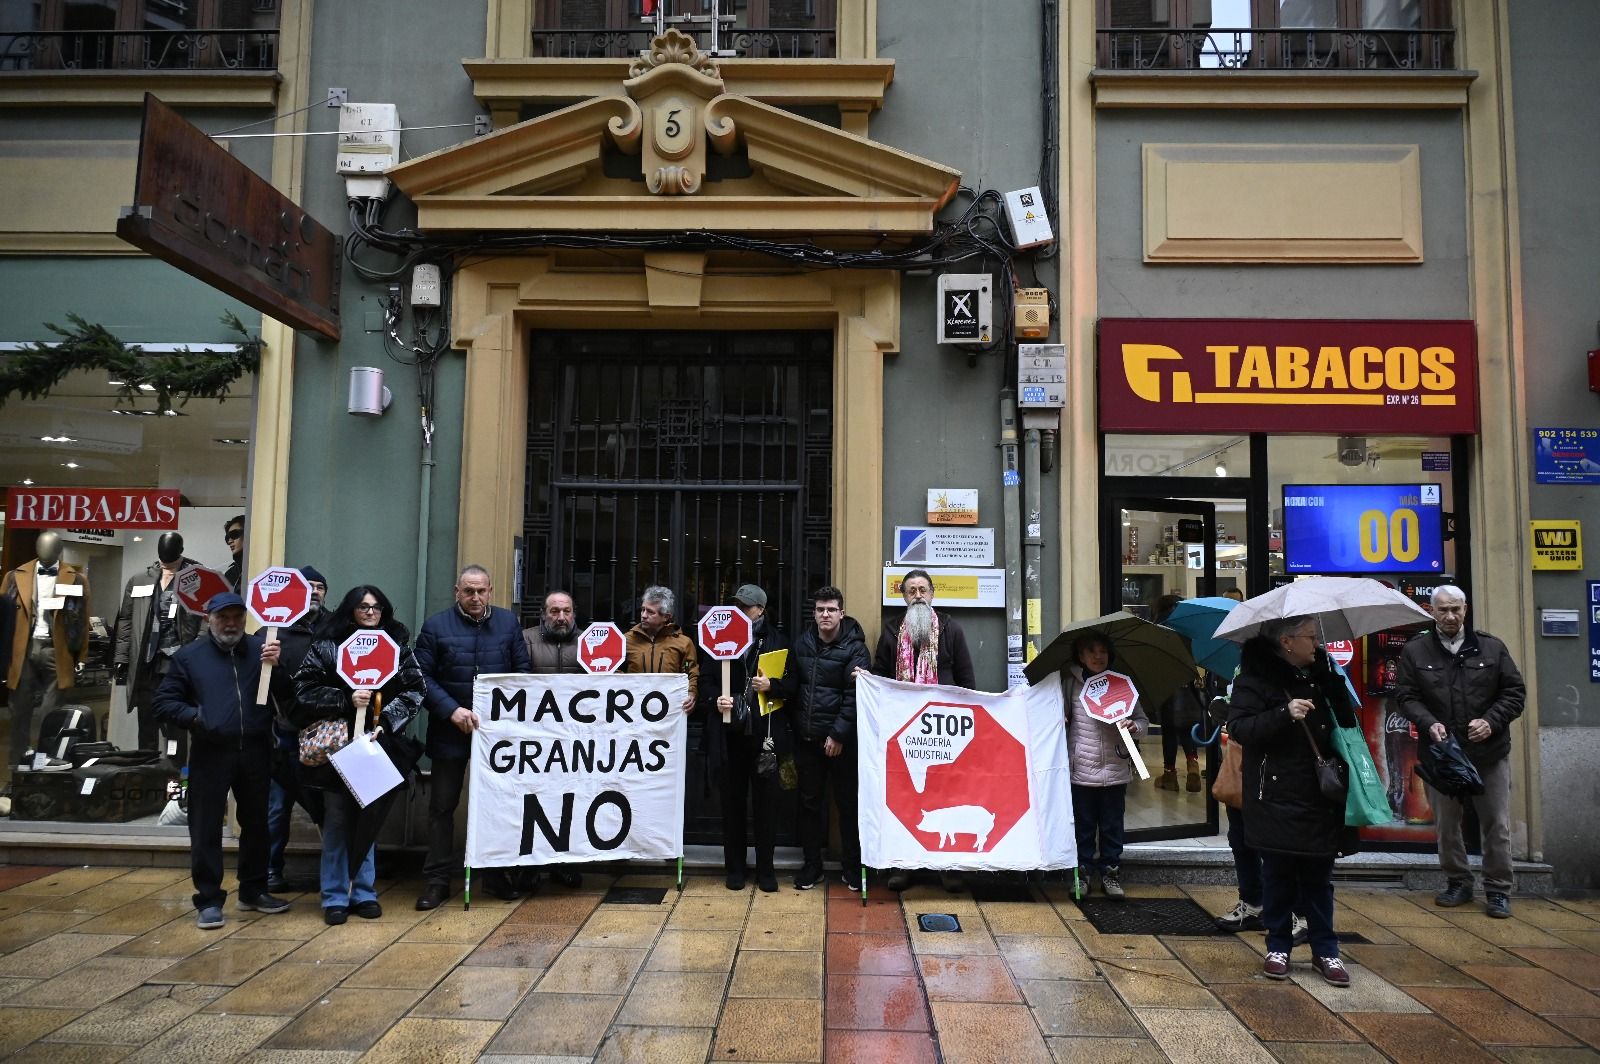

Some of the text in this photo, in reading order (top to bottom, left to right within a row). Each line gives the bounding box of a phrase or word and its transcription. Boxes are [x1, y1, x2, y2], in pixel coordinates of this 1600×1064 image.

[665, 109, 682, 138] 5
[1206, 345, 1456, 391] TABACOS
[1386, 394, 1400, 405] EXP.
[1410, 395, 1419, 405] 26
[1538, 430, 1598, 438] 902 154 539
[11, 494, 176, 523] REBAJAS
[1541, 531, 1572, 546] WU
[180, 572, 199, 585] STOP
[268, 574, 290, 584] STOP
[712, 613, 731, 621] STOP
[591, 629, 608, 637] STOP
[356, 637, 378, 646] STOP
[1090, 678, 1108, 691] STOP
[490, 687, 670, 724] MACRO
[920, 712, 974, 737] STOP
[905, 735, 952, 748] GANADERÍA
[489, 739, 670, 775] GRANJAS
[905, 749, 954, 761] INDUSTRIAL
[518, 790, 632, 857] NO
